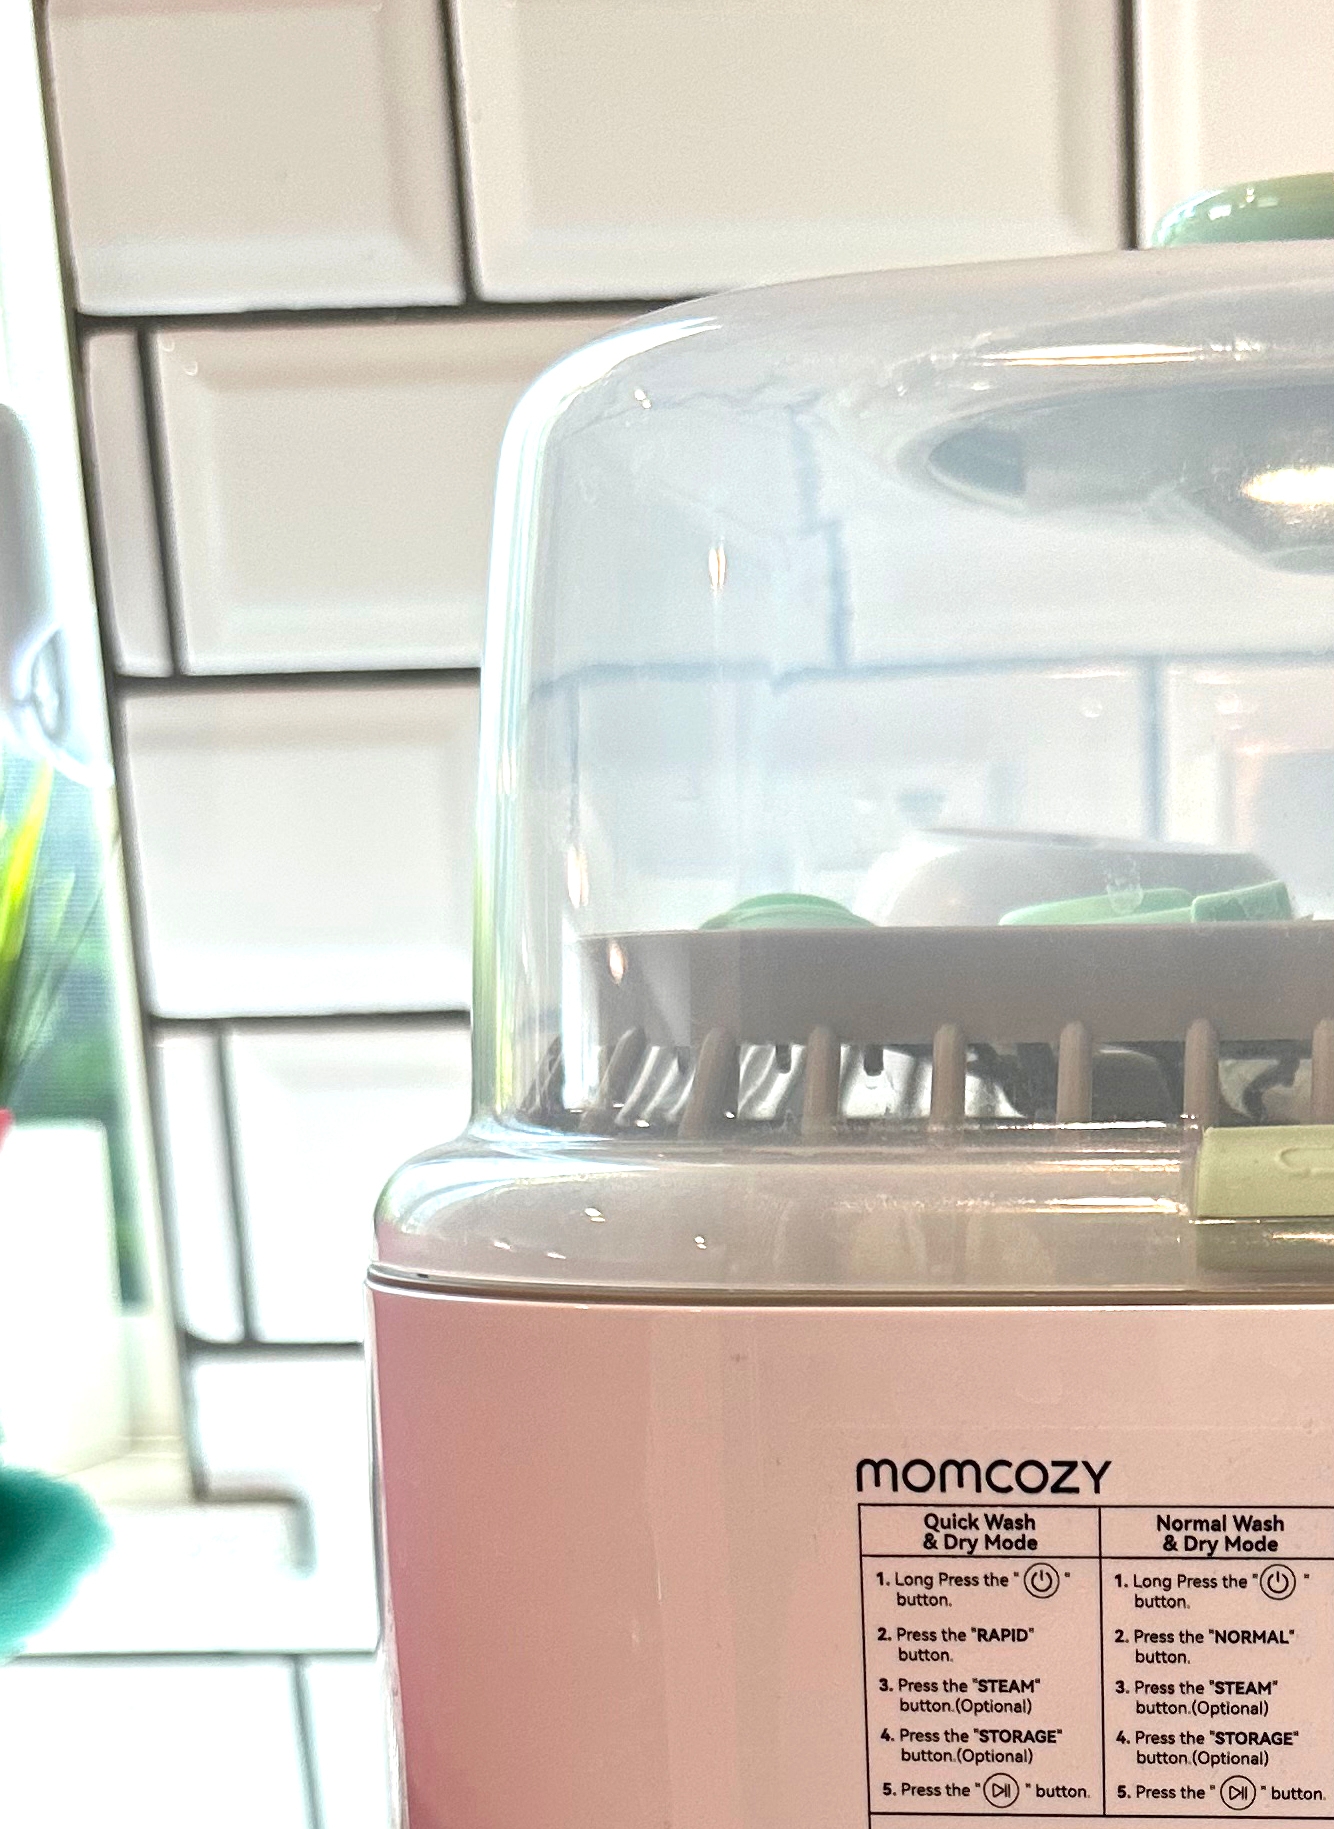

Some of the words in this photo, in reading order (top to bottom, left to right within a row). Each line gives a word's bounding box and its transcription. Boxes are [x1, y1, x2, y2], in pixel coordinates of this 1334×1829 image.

[924, 1513, 980, 1533] Quick
[984, 1512, 1036, 1531] Wash
[1157, 1514, 1227, 1532] Normal
[1232, 1514, 1284, 1532] Wash
[923, 1532, 938, 1550] &
[943, 1535, 977, 1555] Dry
[985, 1533, 1038, 1551] Mode
[1163, 1534, 1178, 1552] &
[1184, 1537, 1219, 1556] Dry
[1225, 1535, 1278, 1552] Mode
[876, 1572, 890, 1586] 1.
[895, 1572, 933, 1590] Long
[939, 1572, 979, 1587] Press
[983, 1572, 1009, 1587] the
[897, 1592, 952, 1607] button.
[877, 1627, 892, 1641] 2.
[897, 1627, 937, 1642] Press
[941, 1627, 966, 1642] the
[971, 1627, 1034, 1642] "RAPID"
[1115, 1629, 1129, 1643] 2.
[1134, 1629, 1174, 1644] Press
[1178, 1629, 1204, 1644] the
[1209, 1629, 1294, 1644] "NORMAL"
[898, 1647, 953, 1662] button.
[1135, 1648, 1190, 1664] button.
[879, 1678, 893, 1692] 3.
[898, 1678, 938, 1692] Press
[942, 1678, 968, 1693] the
[972, 1678, 1040, 1693] "STEAM"
[880, 1728, 895, 1742] 4.
[900, 1728, 940, 1742] Press
[943, 1728, 969, 1743] the
[973, 1728, 1062, 1743] "STORAGE"
[883, 1782, 897, 1796] 5.
[901, 1782, 941, 1796] Press
[945, 1783, 970, 1797] the
[1036, 1784, 1090, 1798] button.
